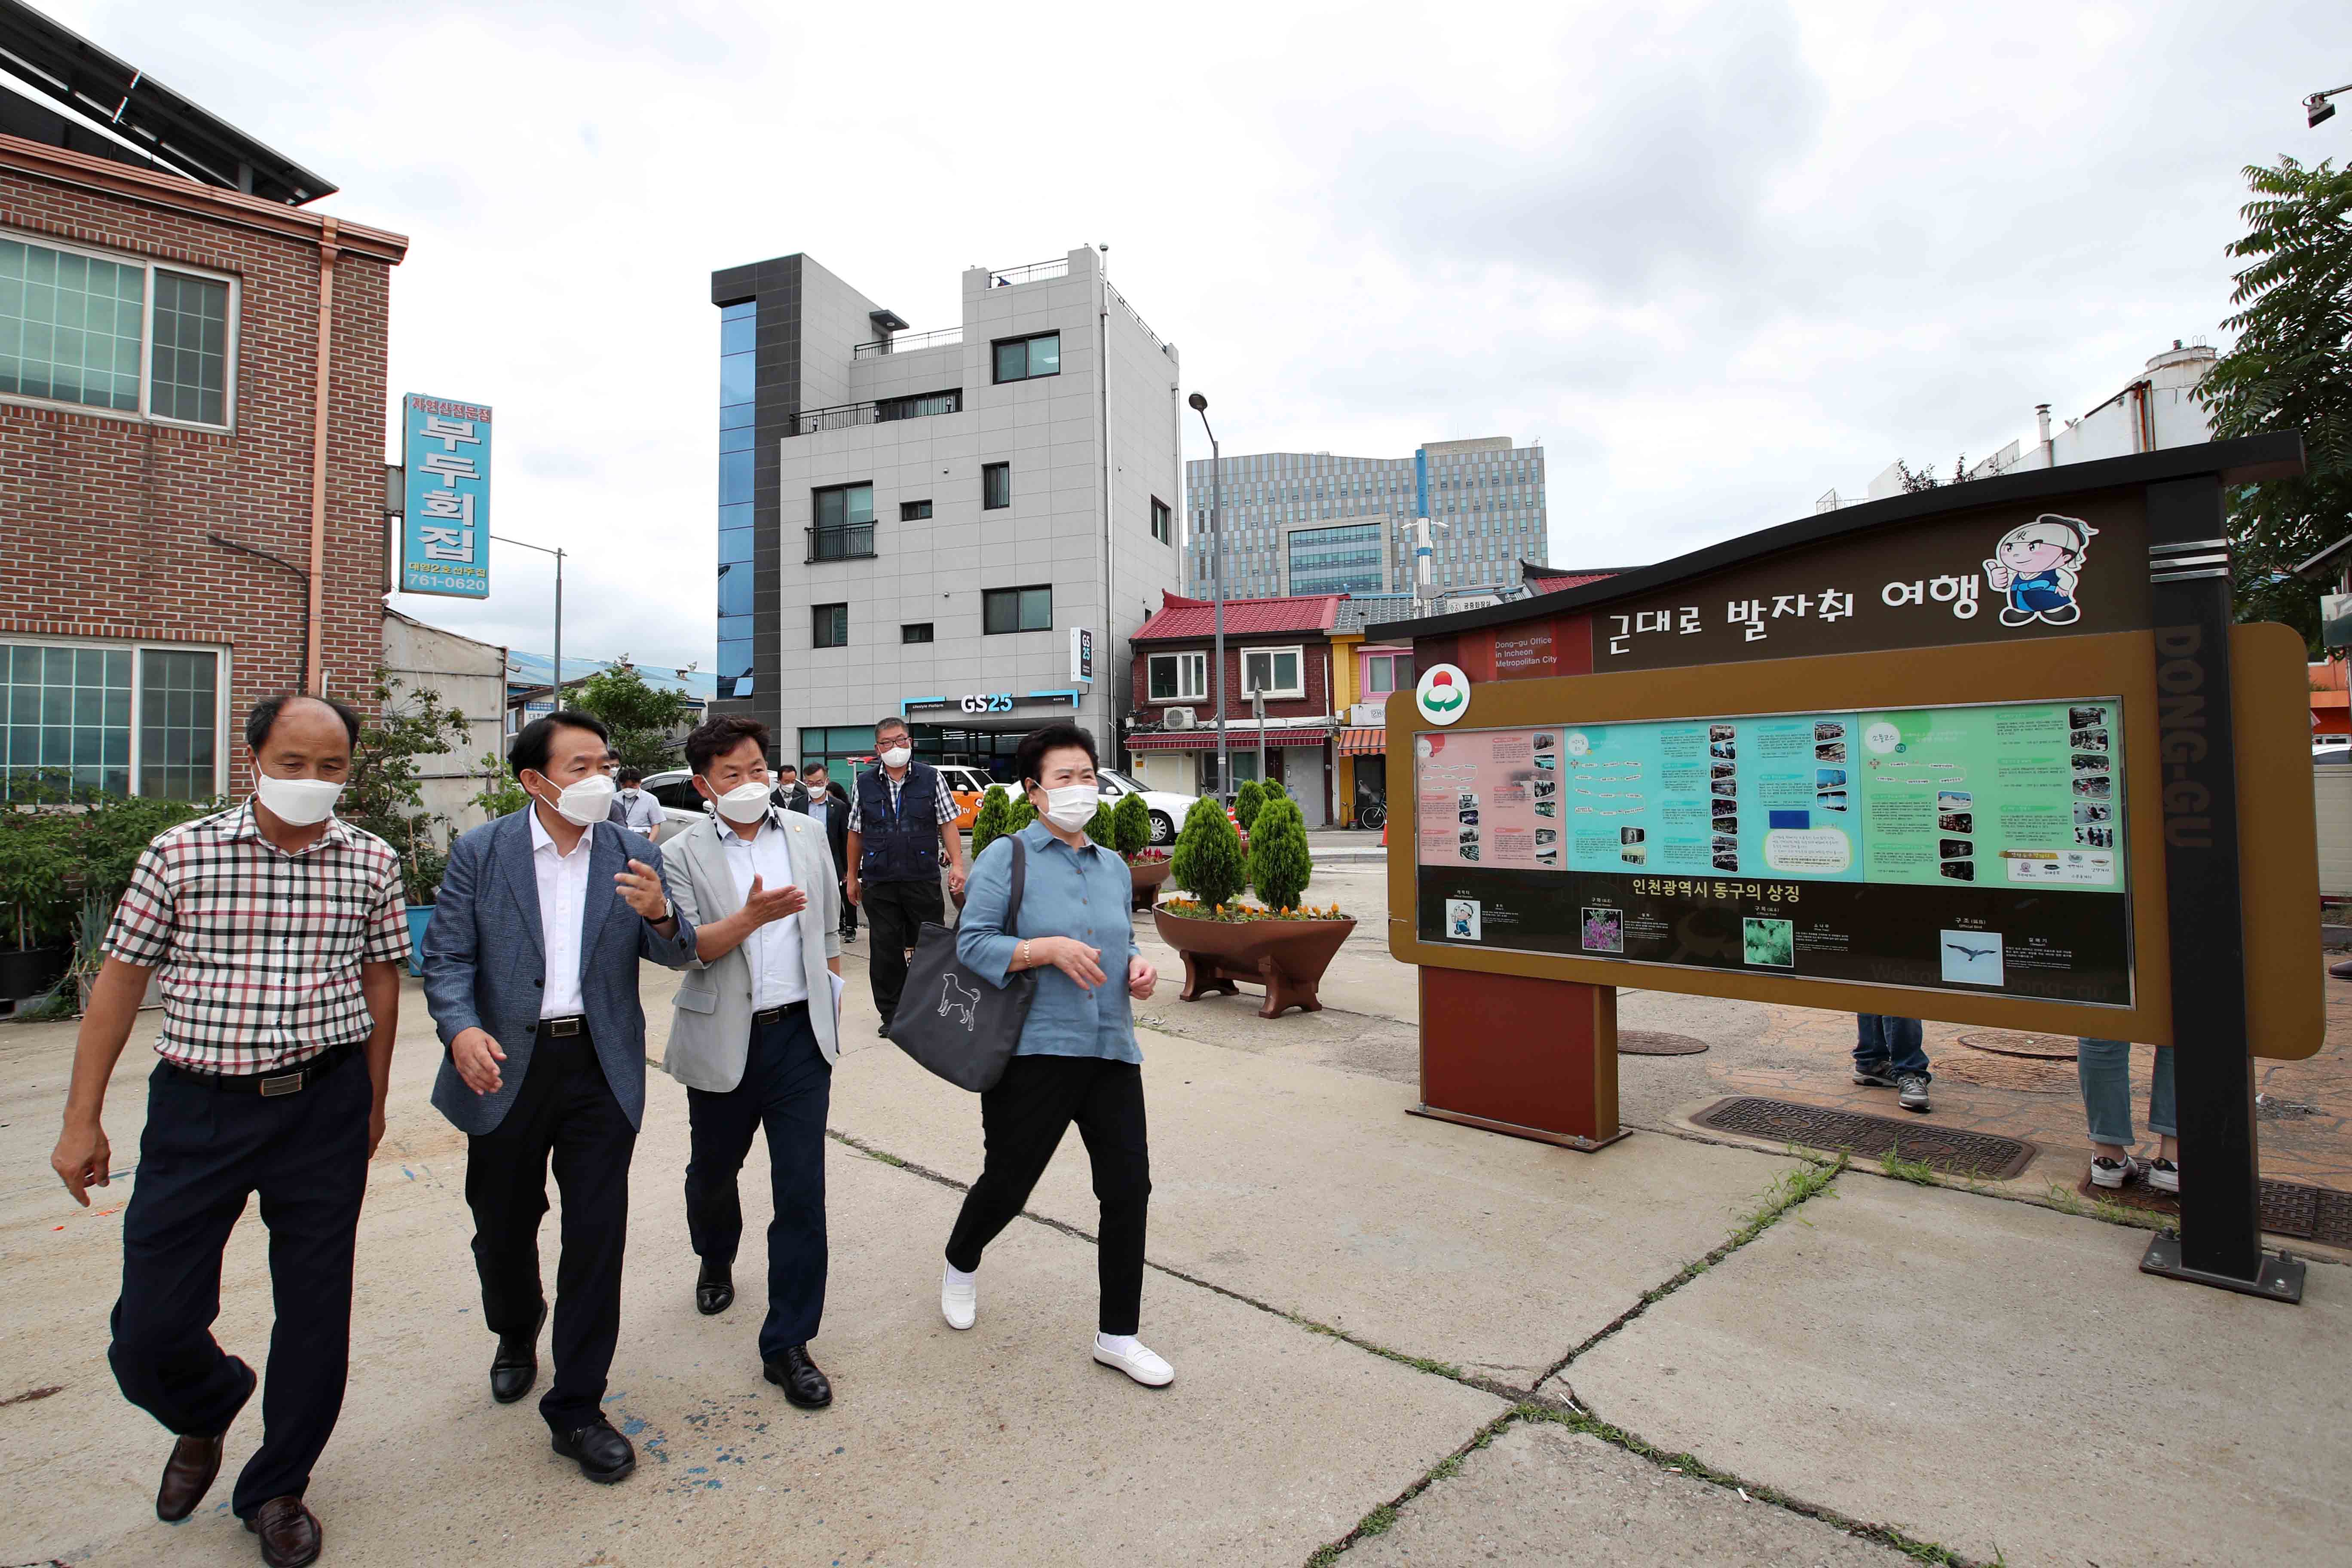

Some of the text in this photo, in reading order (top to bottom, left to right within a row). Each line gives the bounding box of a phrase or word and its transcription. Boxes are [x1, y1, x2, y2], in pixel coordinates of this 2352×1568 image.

[412, 397, 490, 423] 자연산전문점
[417, 416, 481, 564] 부두회집
[409, 574, 485, 591] 761-0620
[1610, 575, 1979, 655] 근대로 발자취 여행
[1495, 637, 1552, 649] Dong-gu Office
[1504, 649, 1533, 657] Incheon
[1496, 655, 1557, 668] Metropolitan City
[961, 693, 1013, 714] GS25
[1633, 879, 1800, 903] 인천광역시 동구의 상징
